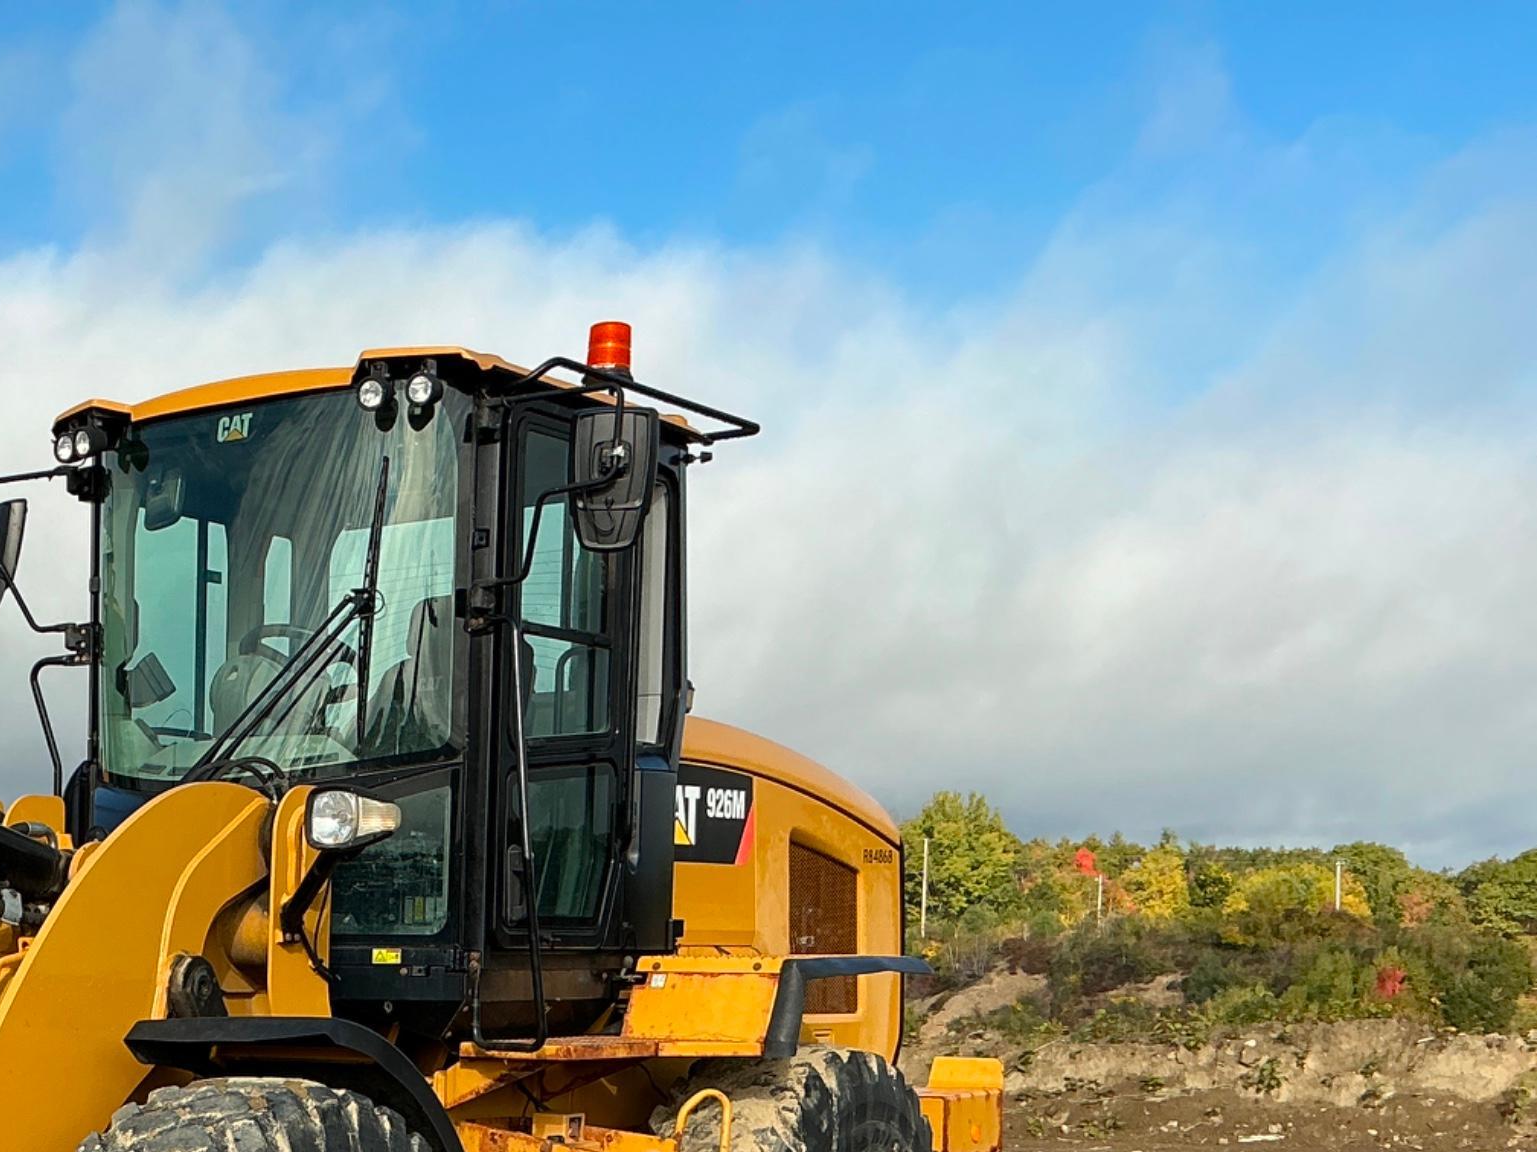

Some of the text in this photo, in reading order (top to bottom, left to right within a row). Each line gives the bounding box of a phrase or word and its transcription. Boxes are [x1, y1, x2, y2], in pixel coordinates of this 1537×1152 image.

[216, 412, 254, 443] CAT
[674, 784, 746, 846] AT 926M
